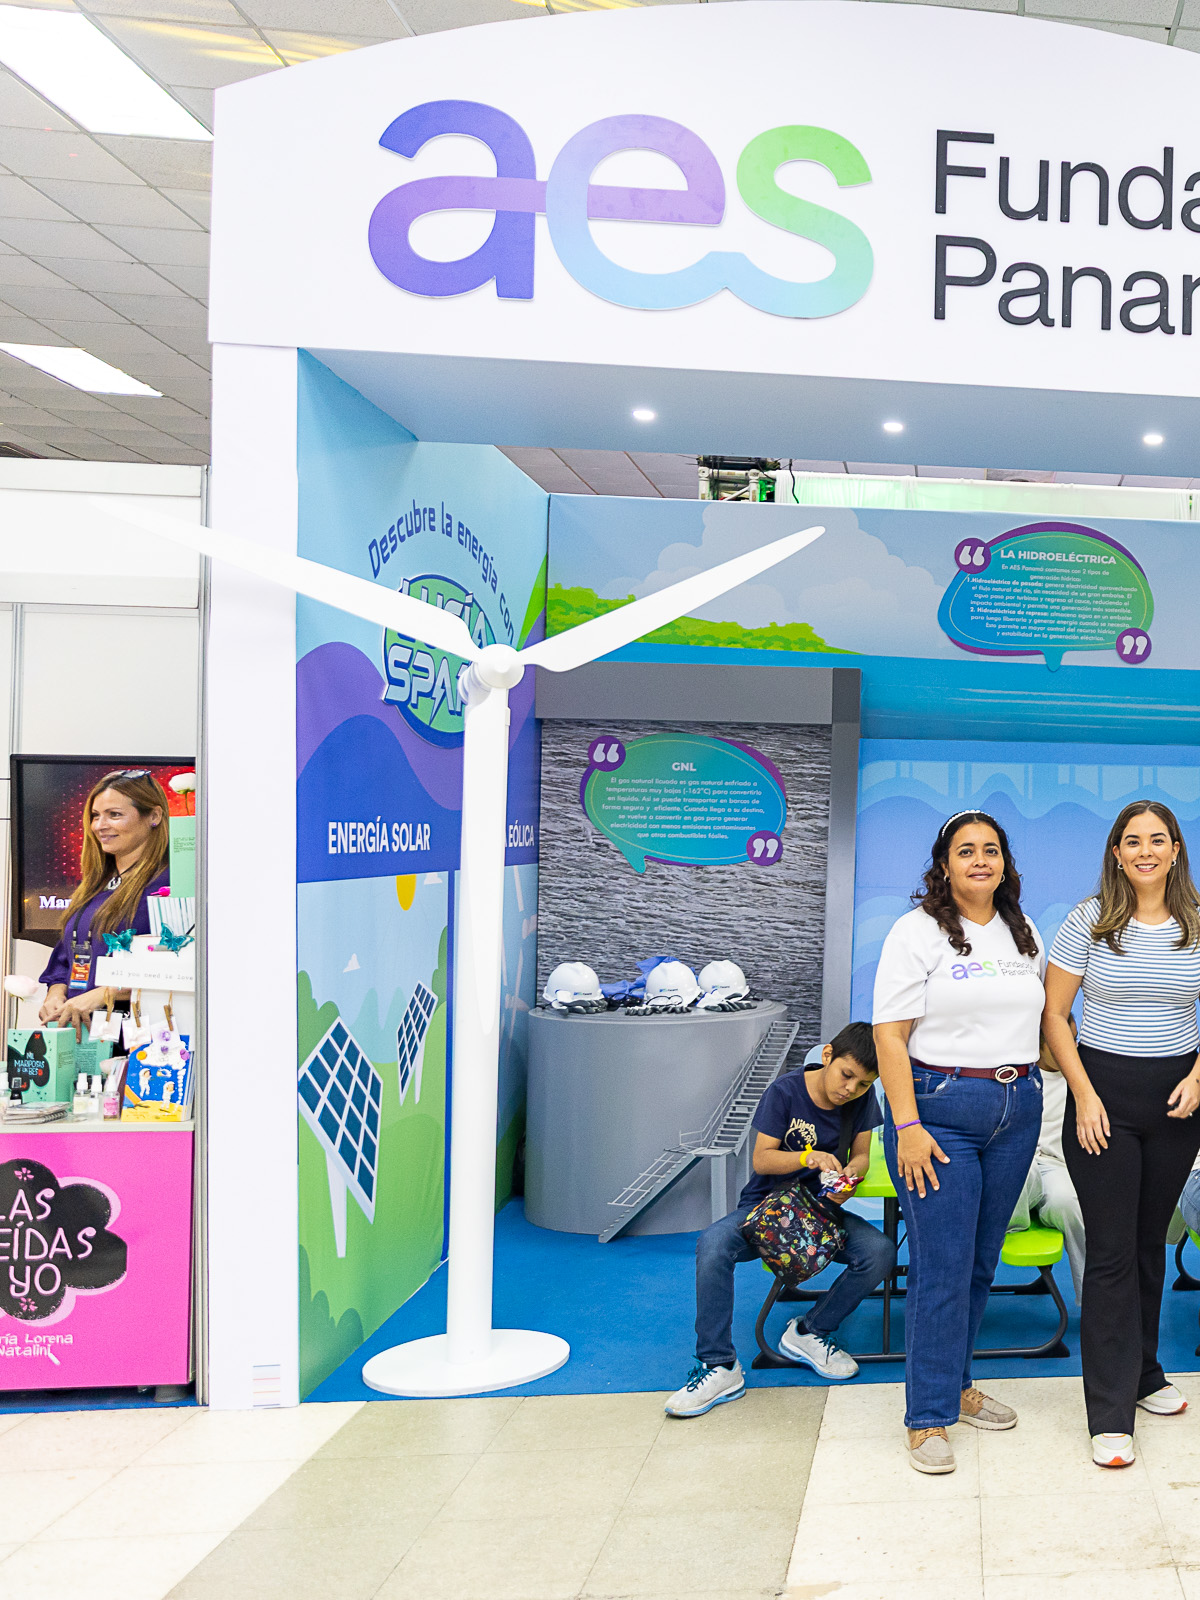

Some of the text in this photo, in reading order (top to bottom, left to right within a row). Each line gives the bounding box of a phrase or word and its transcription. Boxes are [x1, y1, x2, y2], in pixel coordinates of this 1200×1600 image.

[368, 99, 874, 319] aes
[1000, 549, 1117, 564] LA HIDROELÉCTRICA
[368, 498, 436, 580] Descubre
[441, 501, 453, 538] la
[499, 592, 514, 646] con
[672, 762, 697, 772] GNL
[328, 816, 431, 854] ENERGÍA SOLAR
[508, 819, 535, 848] EÓLICA
[128, 972, 140, 980] you
[144, 971, 161, 979] need
[165, 972, 173, 980] is
[177, 972, 194, 981] love
[950, 960, 997, 980] aes
[0, 1188, 55, 1221] AS
[9, 1263, 62, 1298] YO
[25, 1333, 74, 1345] Lorena
